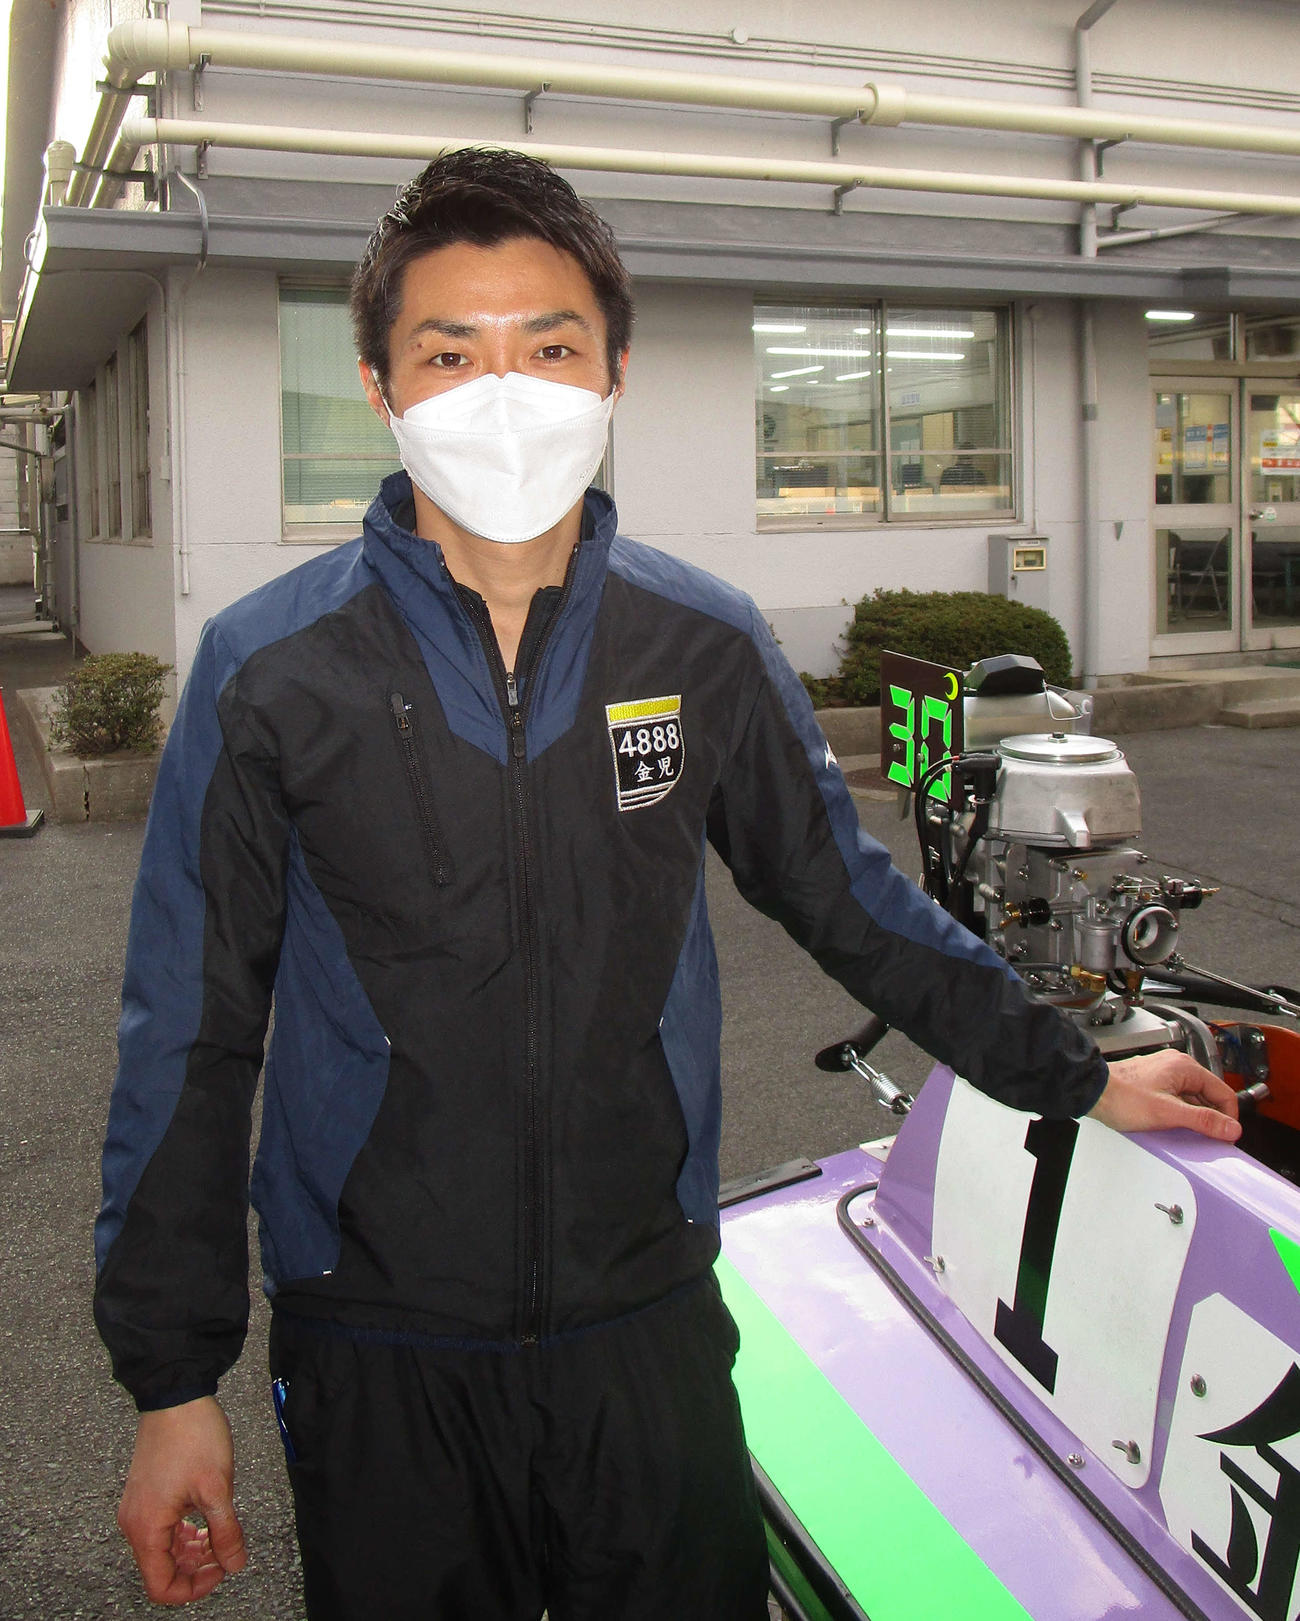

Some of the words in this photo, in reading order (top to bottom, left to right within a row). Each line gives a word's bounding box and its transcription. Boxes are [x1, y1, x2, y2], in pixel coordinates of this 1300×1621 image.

[619, 723, 680, 758] 4888
[634, 756, 675, 783] 金児
[888, 684, 952, 804] 30
[994, 1117, 1080, 1397] 1
